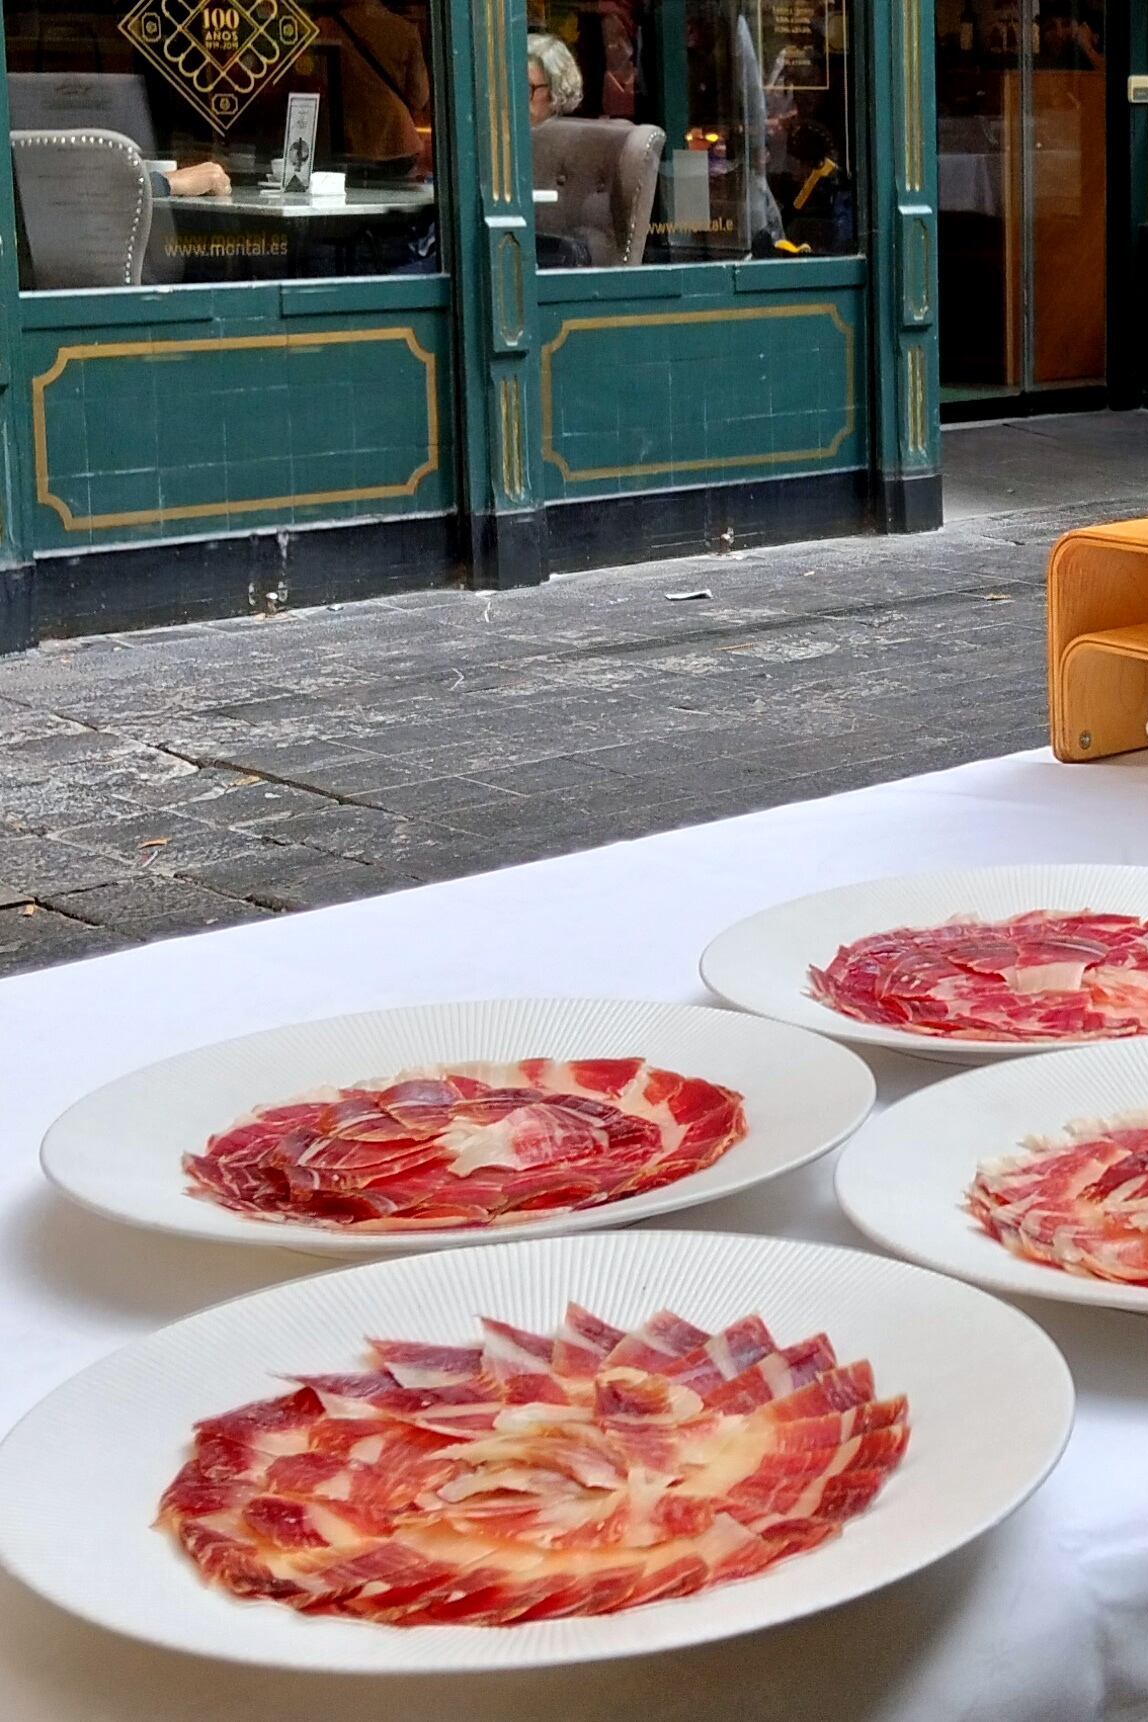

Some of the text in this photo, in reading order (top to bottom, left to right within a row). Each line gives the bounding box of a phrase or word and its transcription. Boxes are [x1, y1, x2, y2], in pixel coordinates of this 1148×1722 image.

[203, 8, 240, 30] 100
[205, 29, 239, 41] AÑOS
[164, 239, 288, 257] www.montal.es
